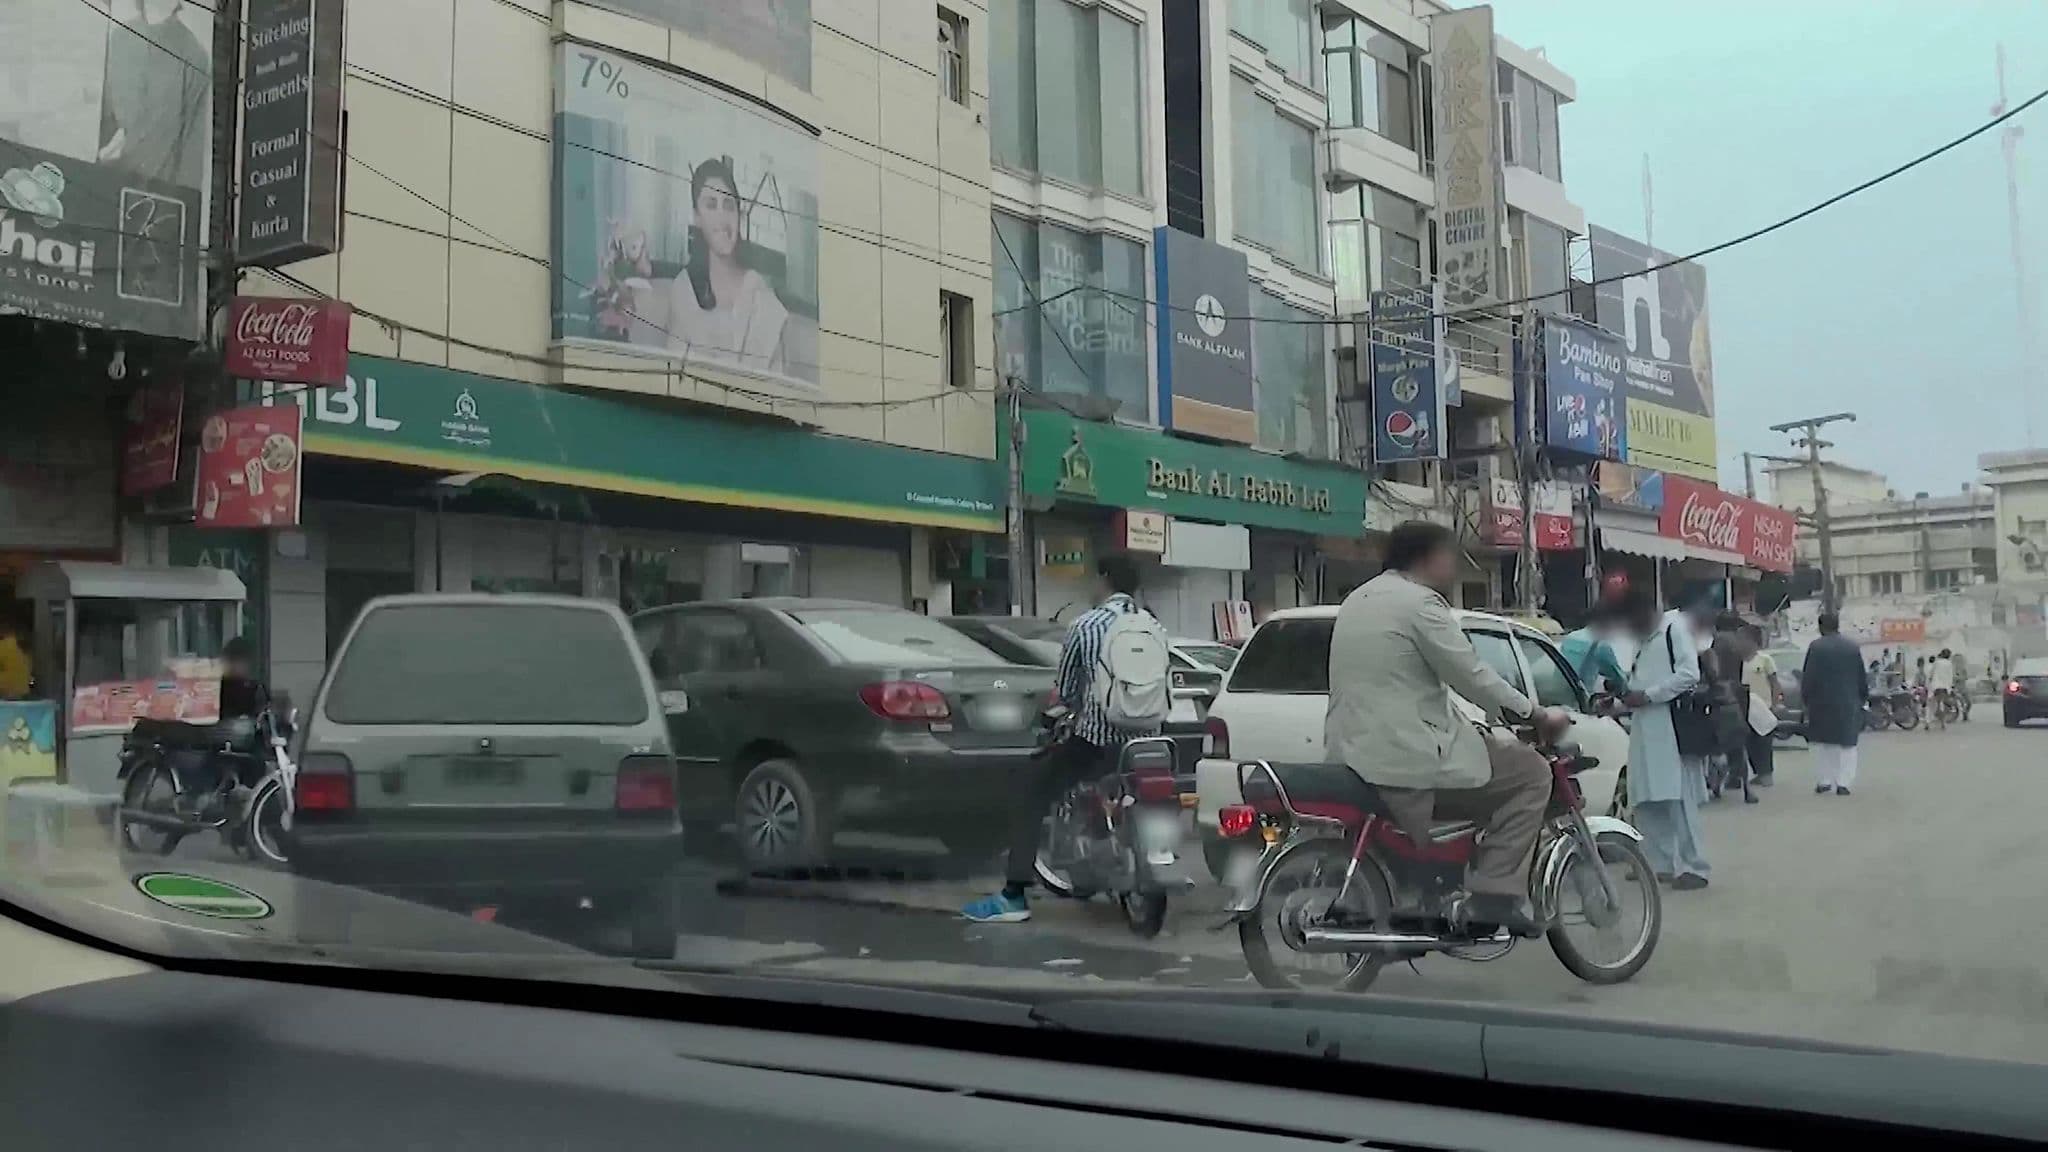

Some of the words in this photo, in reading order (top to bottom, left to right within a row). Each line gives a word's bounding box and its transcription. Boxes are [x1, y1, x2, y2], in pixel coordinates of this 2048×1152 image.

[251, 17, 309, 50] Stitching
[246, 73, 309, 110] Garments
[578, 53, 629, 99] 7%
[251, 127, 300, 158] Formal
[250, 158, 298, 188] Casual
[237, 303, 319, 345] Coca-Cola
[1560, 328, 1620, 374] Bambino
[1150, 457, 1201, 494] Bank
[1243, 474, 1296, 506] Habib
[1301, 484, 1330, 513] Ltd
[1681, 492, 1744, 549] Coca-Cola
